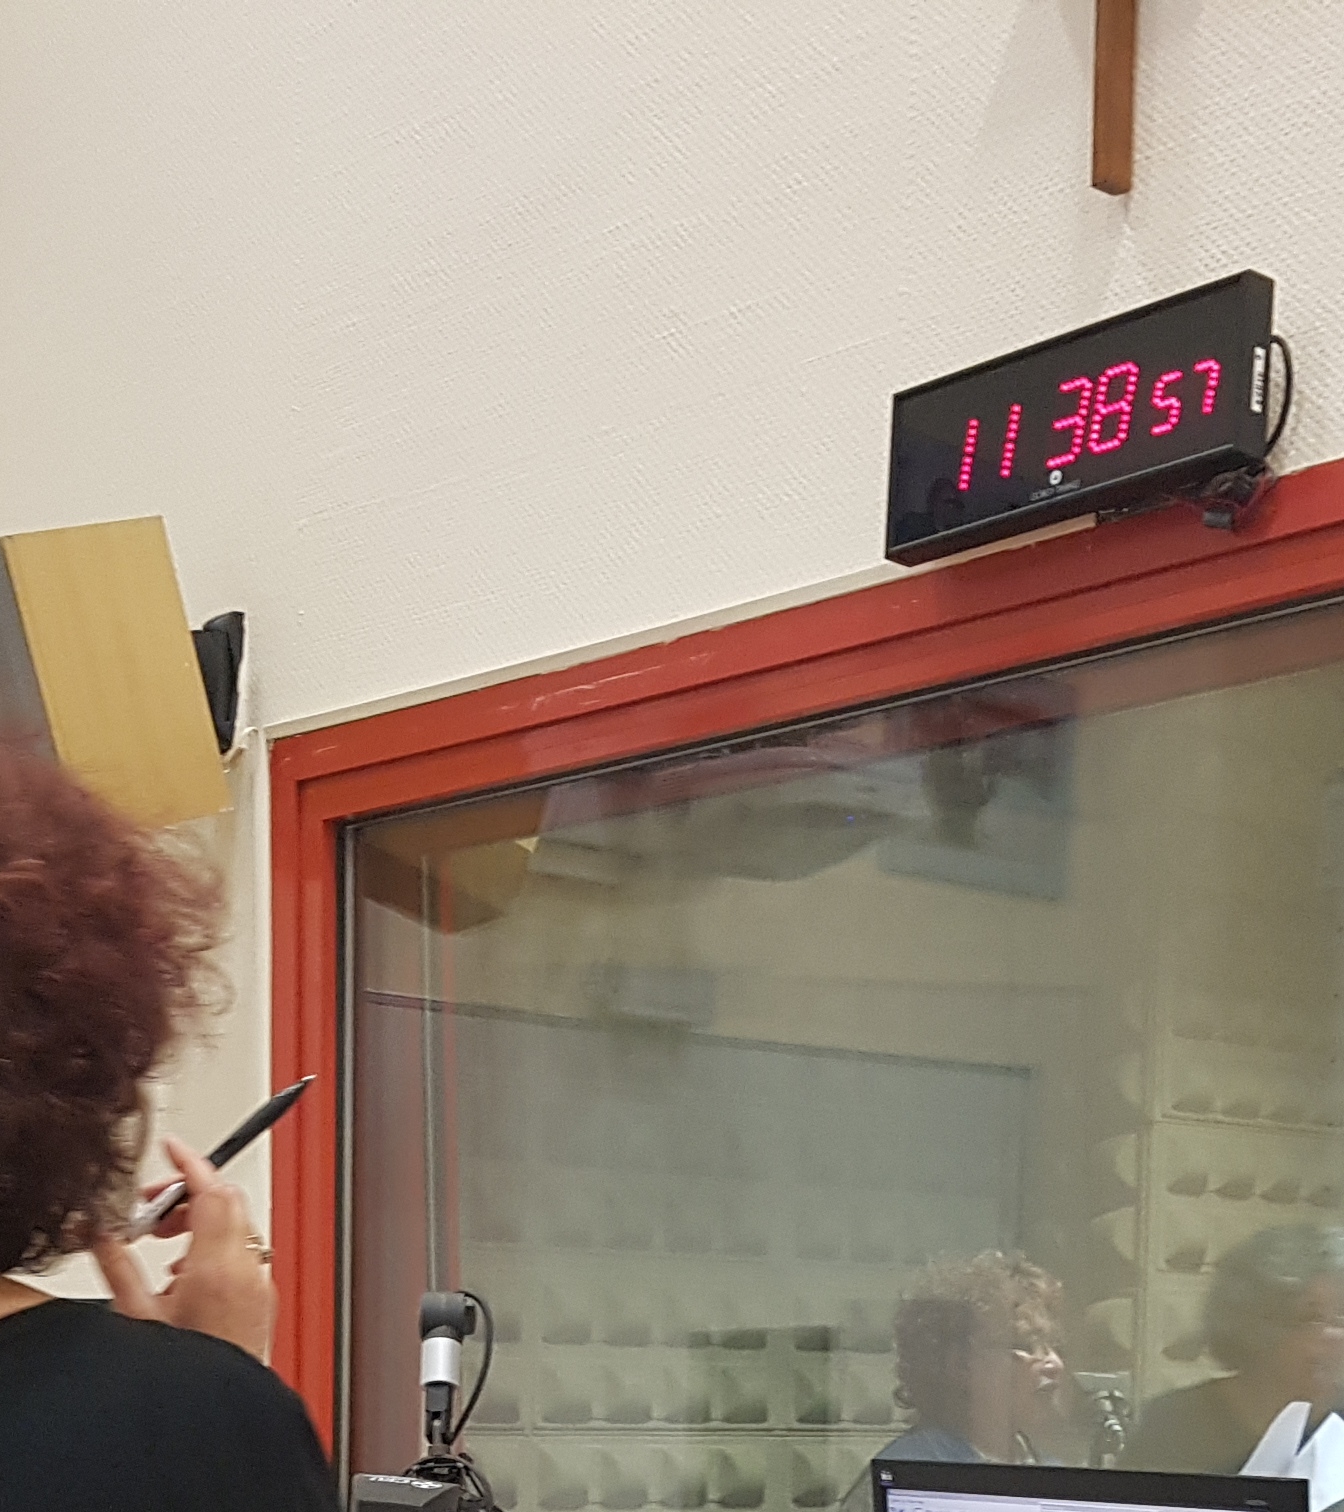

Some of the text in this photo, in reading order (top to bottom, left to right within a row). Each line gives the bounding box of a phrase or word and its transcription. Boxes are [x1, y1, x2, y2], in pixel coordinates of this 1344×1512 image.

[957, 403, 1022, 491] 11
[1045, 361, 1141, 470] 38
[1149, 358, 1223, 437] 57
